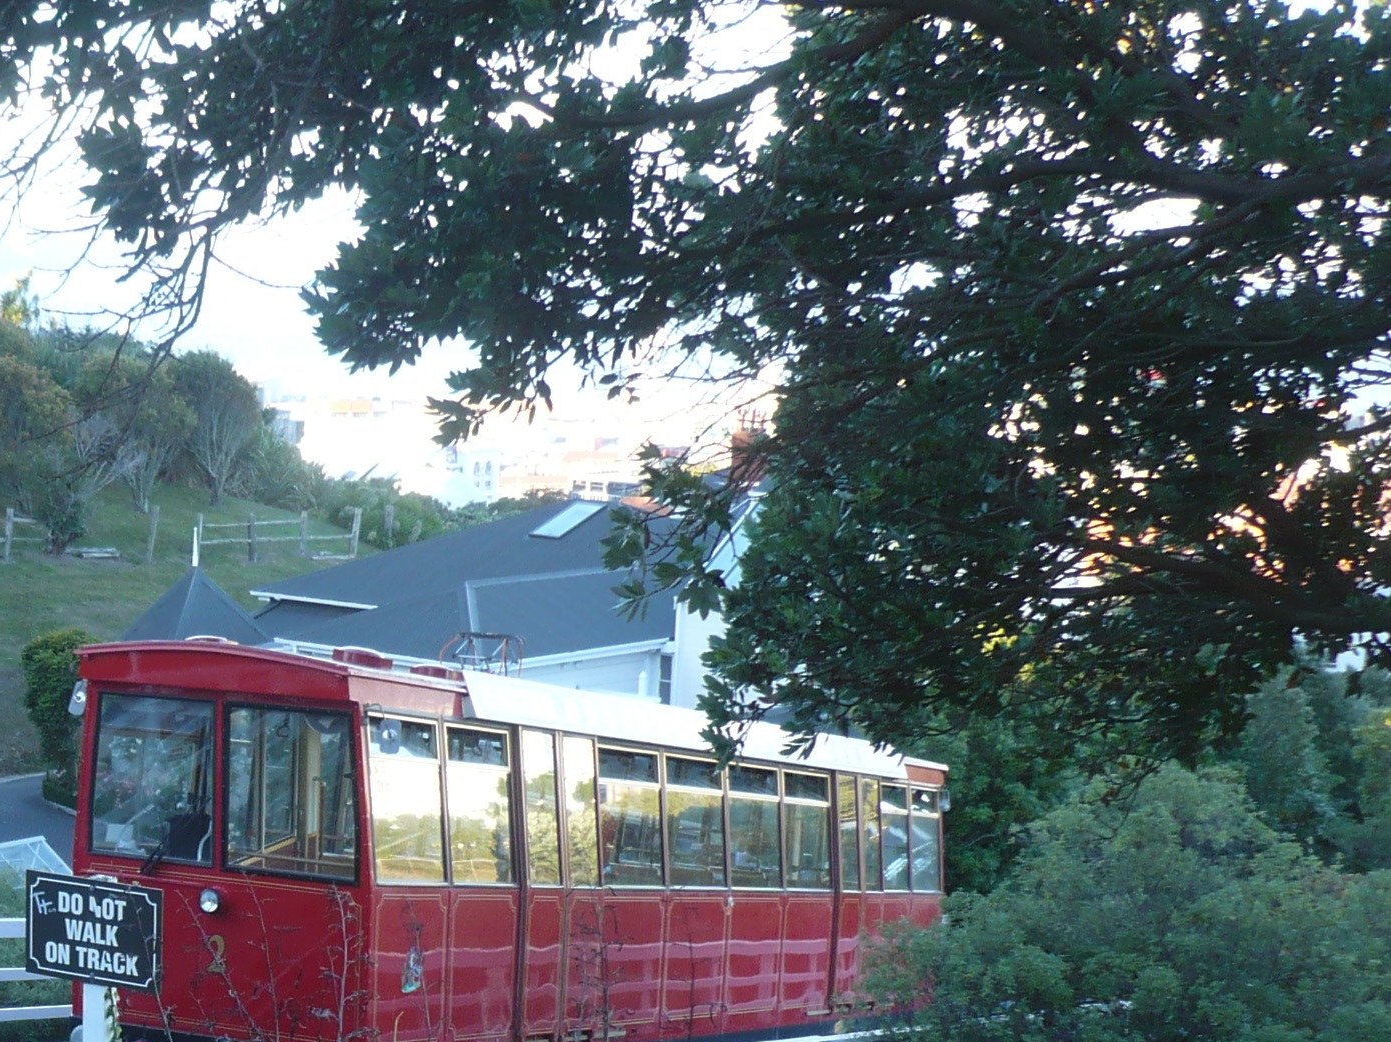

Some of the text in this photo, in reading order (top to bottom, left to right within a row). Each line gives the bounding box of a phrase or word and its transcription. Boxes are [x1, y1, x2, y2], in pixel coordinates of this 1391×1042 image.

[58, 891, 83, 915] DO
[89, 895, 127, 921] NOT
[64, 918, 119, 947] WALK
[45, 941, 139, 976] ON TRACK
